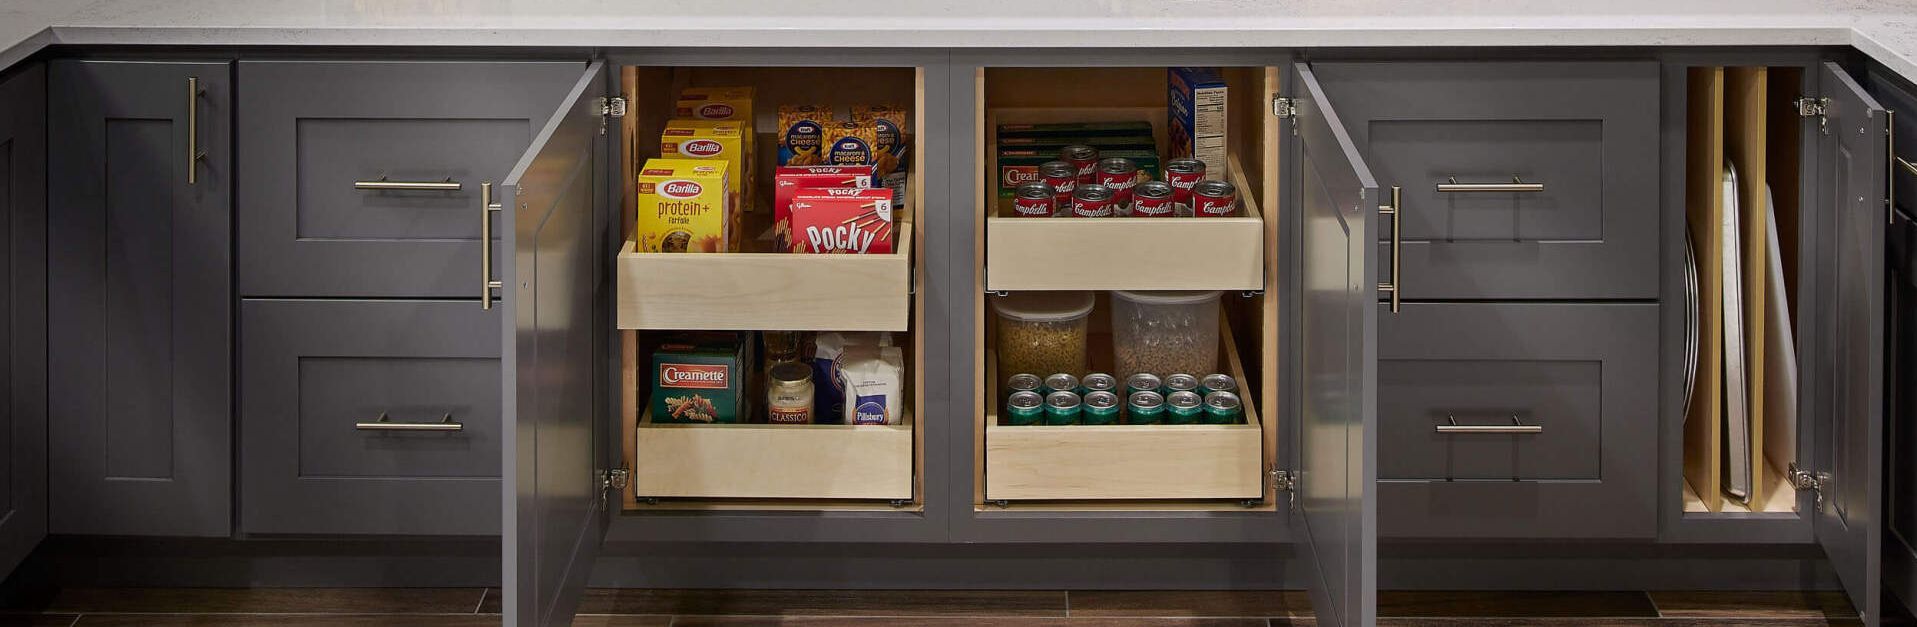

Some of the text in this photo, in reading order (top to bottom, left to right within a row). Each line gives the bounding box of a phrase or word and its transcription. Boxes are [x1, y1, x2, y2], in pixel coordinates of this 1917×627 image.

[703, 107, 731, 116] Barilla
[689, 143, 719, 152] Barilla
[667, 183, 700, 193] Barilla
[880, 203, 887, 211] 6
[771, 413, 807, 422] CLASSICO
[857, 411, 884, 422] Pillsbury
